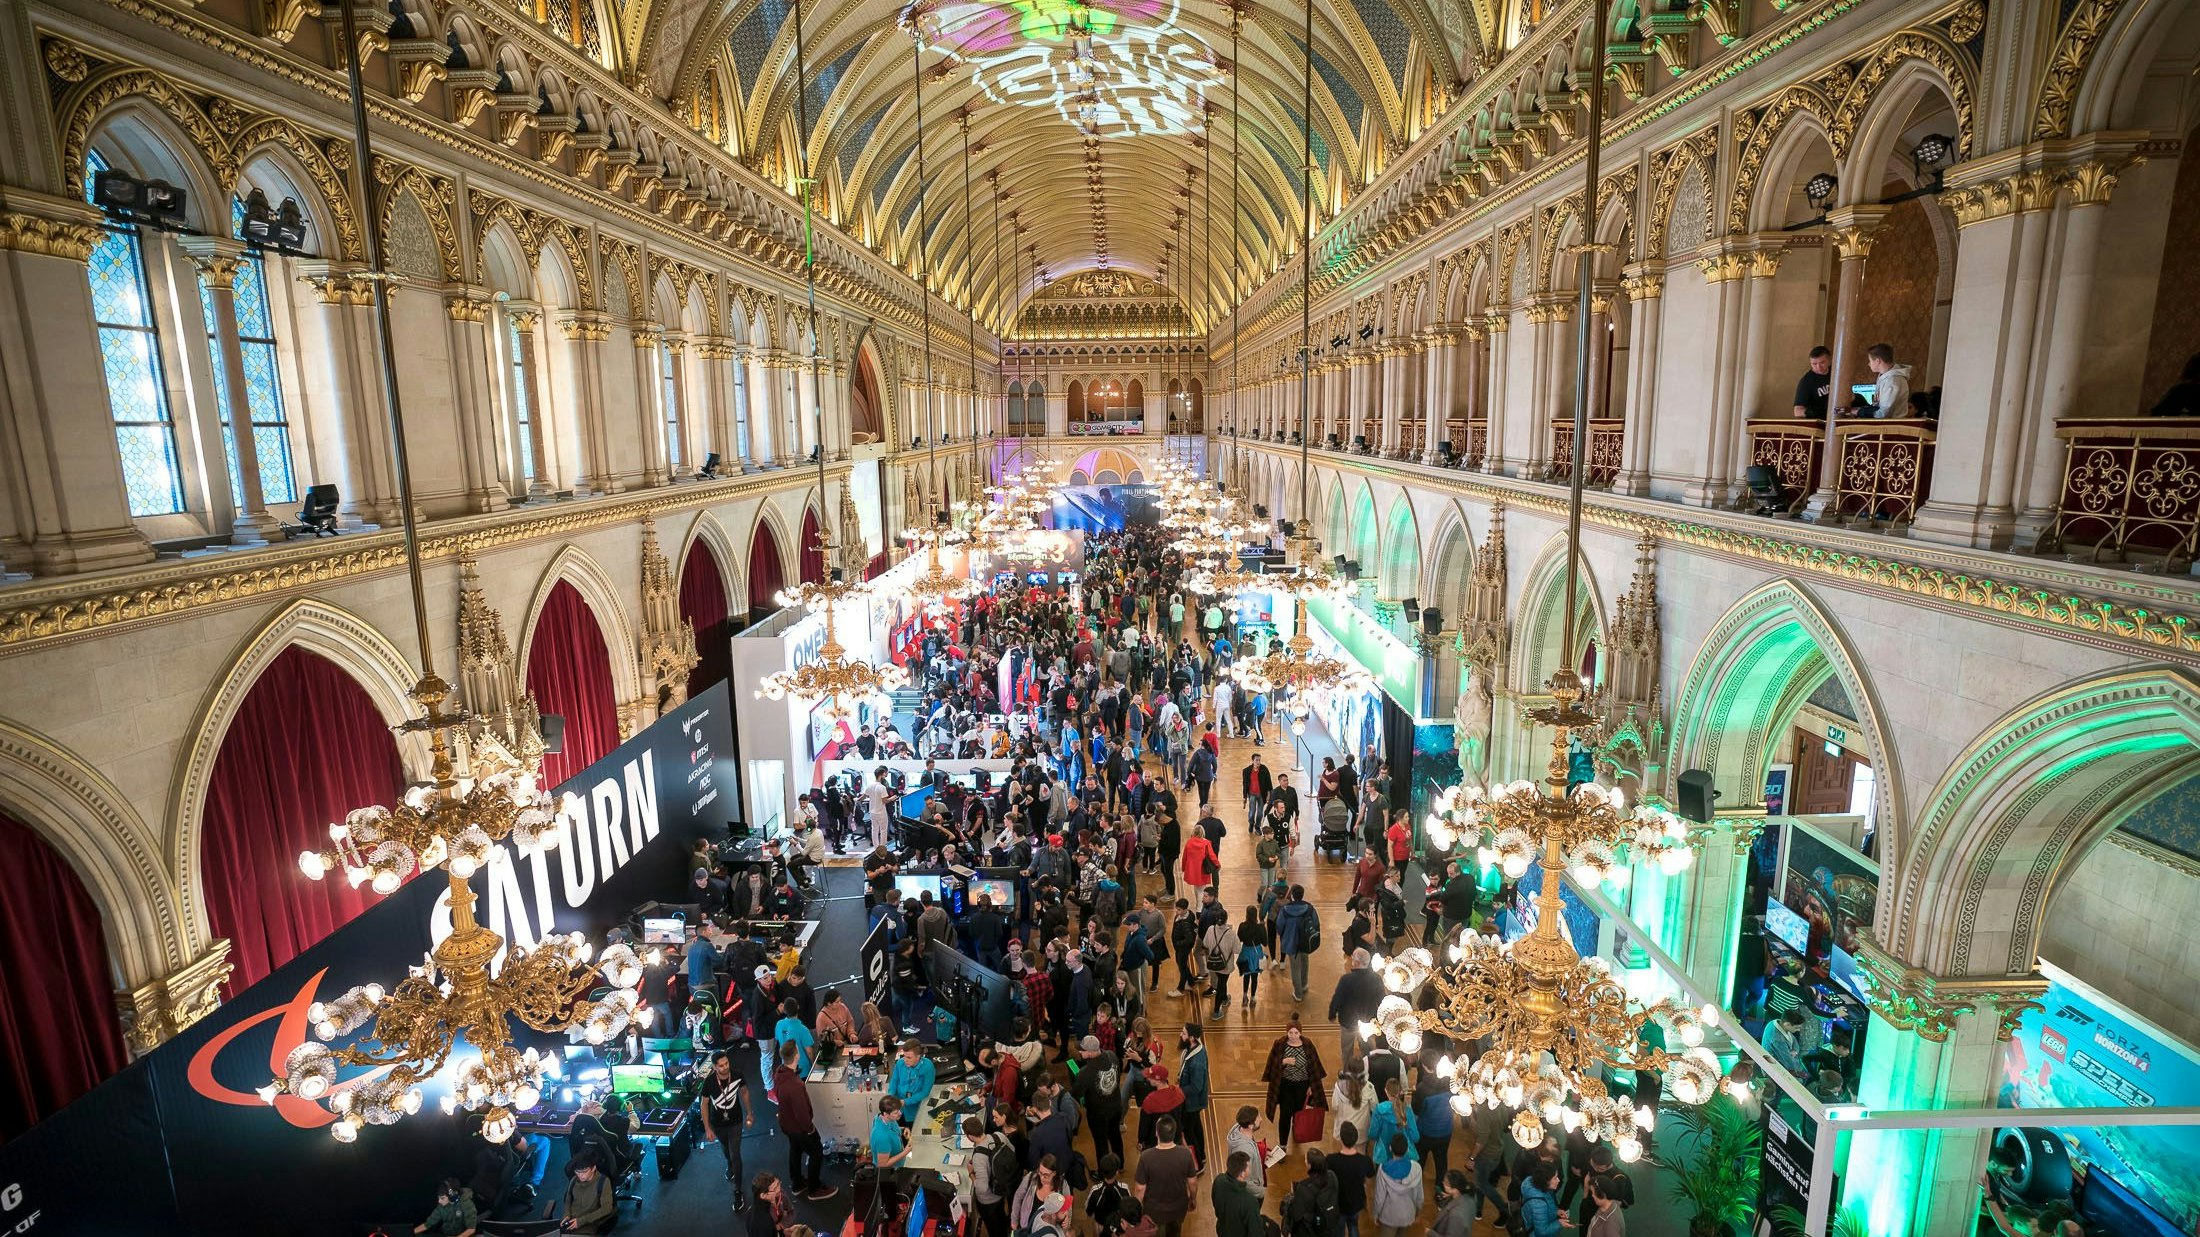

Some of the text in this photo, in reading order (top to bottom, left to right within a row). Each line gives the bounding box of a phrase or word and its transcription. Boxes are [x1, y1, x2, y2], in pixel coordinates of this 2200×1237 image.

[2041, 1033, 2066, 1054] LEGO
[2094, 1033, 2149, 1072] HORIZON 4
[2096, 1023, 2151, 1062] FORZA
[2070, 1050, 2155, 1106] SPEED
[1765, 1152, 1798, 1190] nächsten
[1766, 1141, 1795, 1175] Gaming
[1795, 1171, 1810, 1188] auf
[15, 1209, 41, 1233] OF
